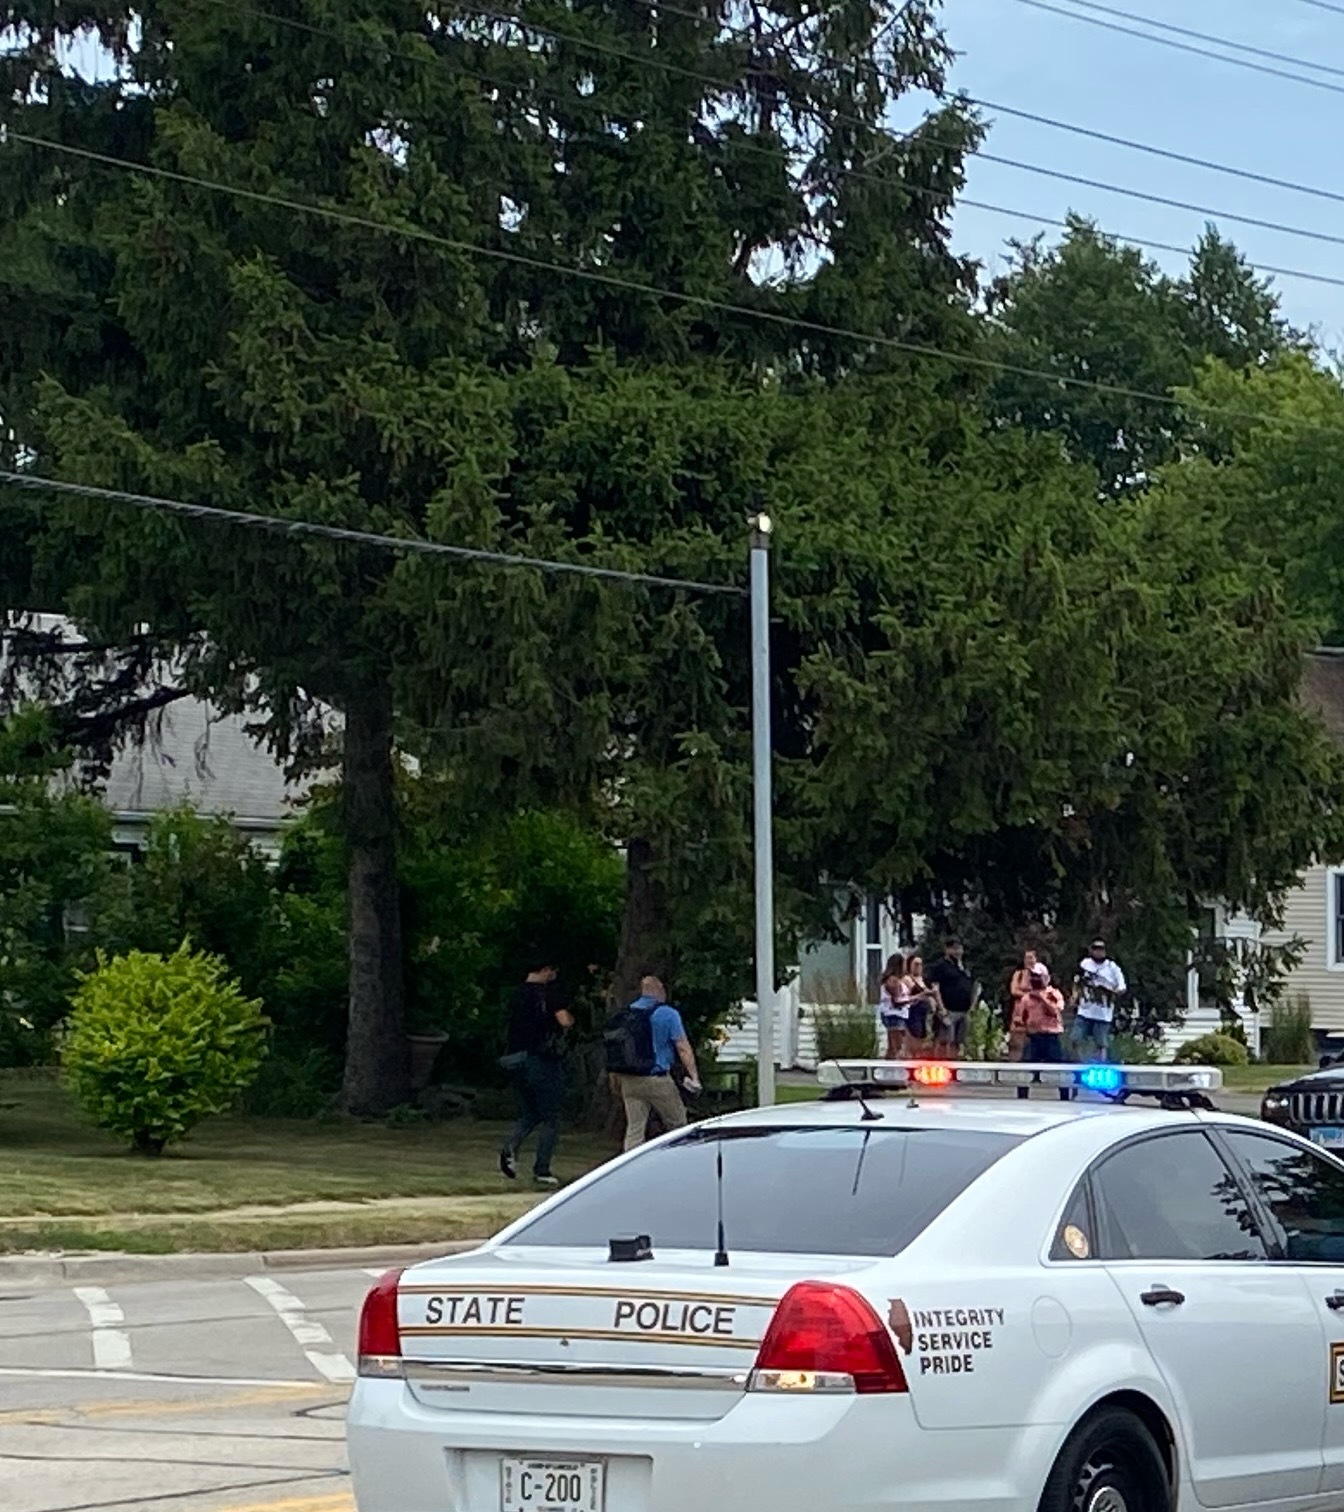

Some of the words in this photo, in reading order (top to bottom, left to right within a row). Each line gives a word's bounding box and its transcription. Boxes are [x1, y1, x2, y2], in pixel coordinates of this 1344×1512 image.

[425, 1296, 526, 1325] STATE
[613, 1300, 737, 1334] POLICE
[913, 1307, 1005, 1329] INTEGRITY
[918, 1331, 993, 1352] SERVICE
[920, 1354, 974, 1375] PRIDE
[520, 1471, 581, 1503] C-200
